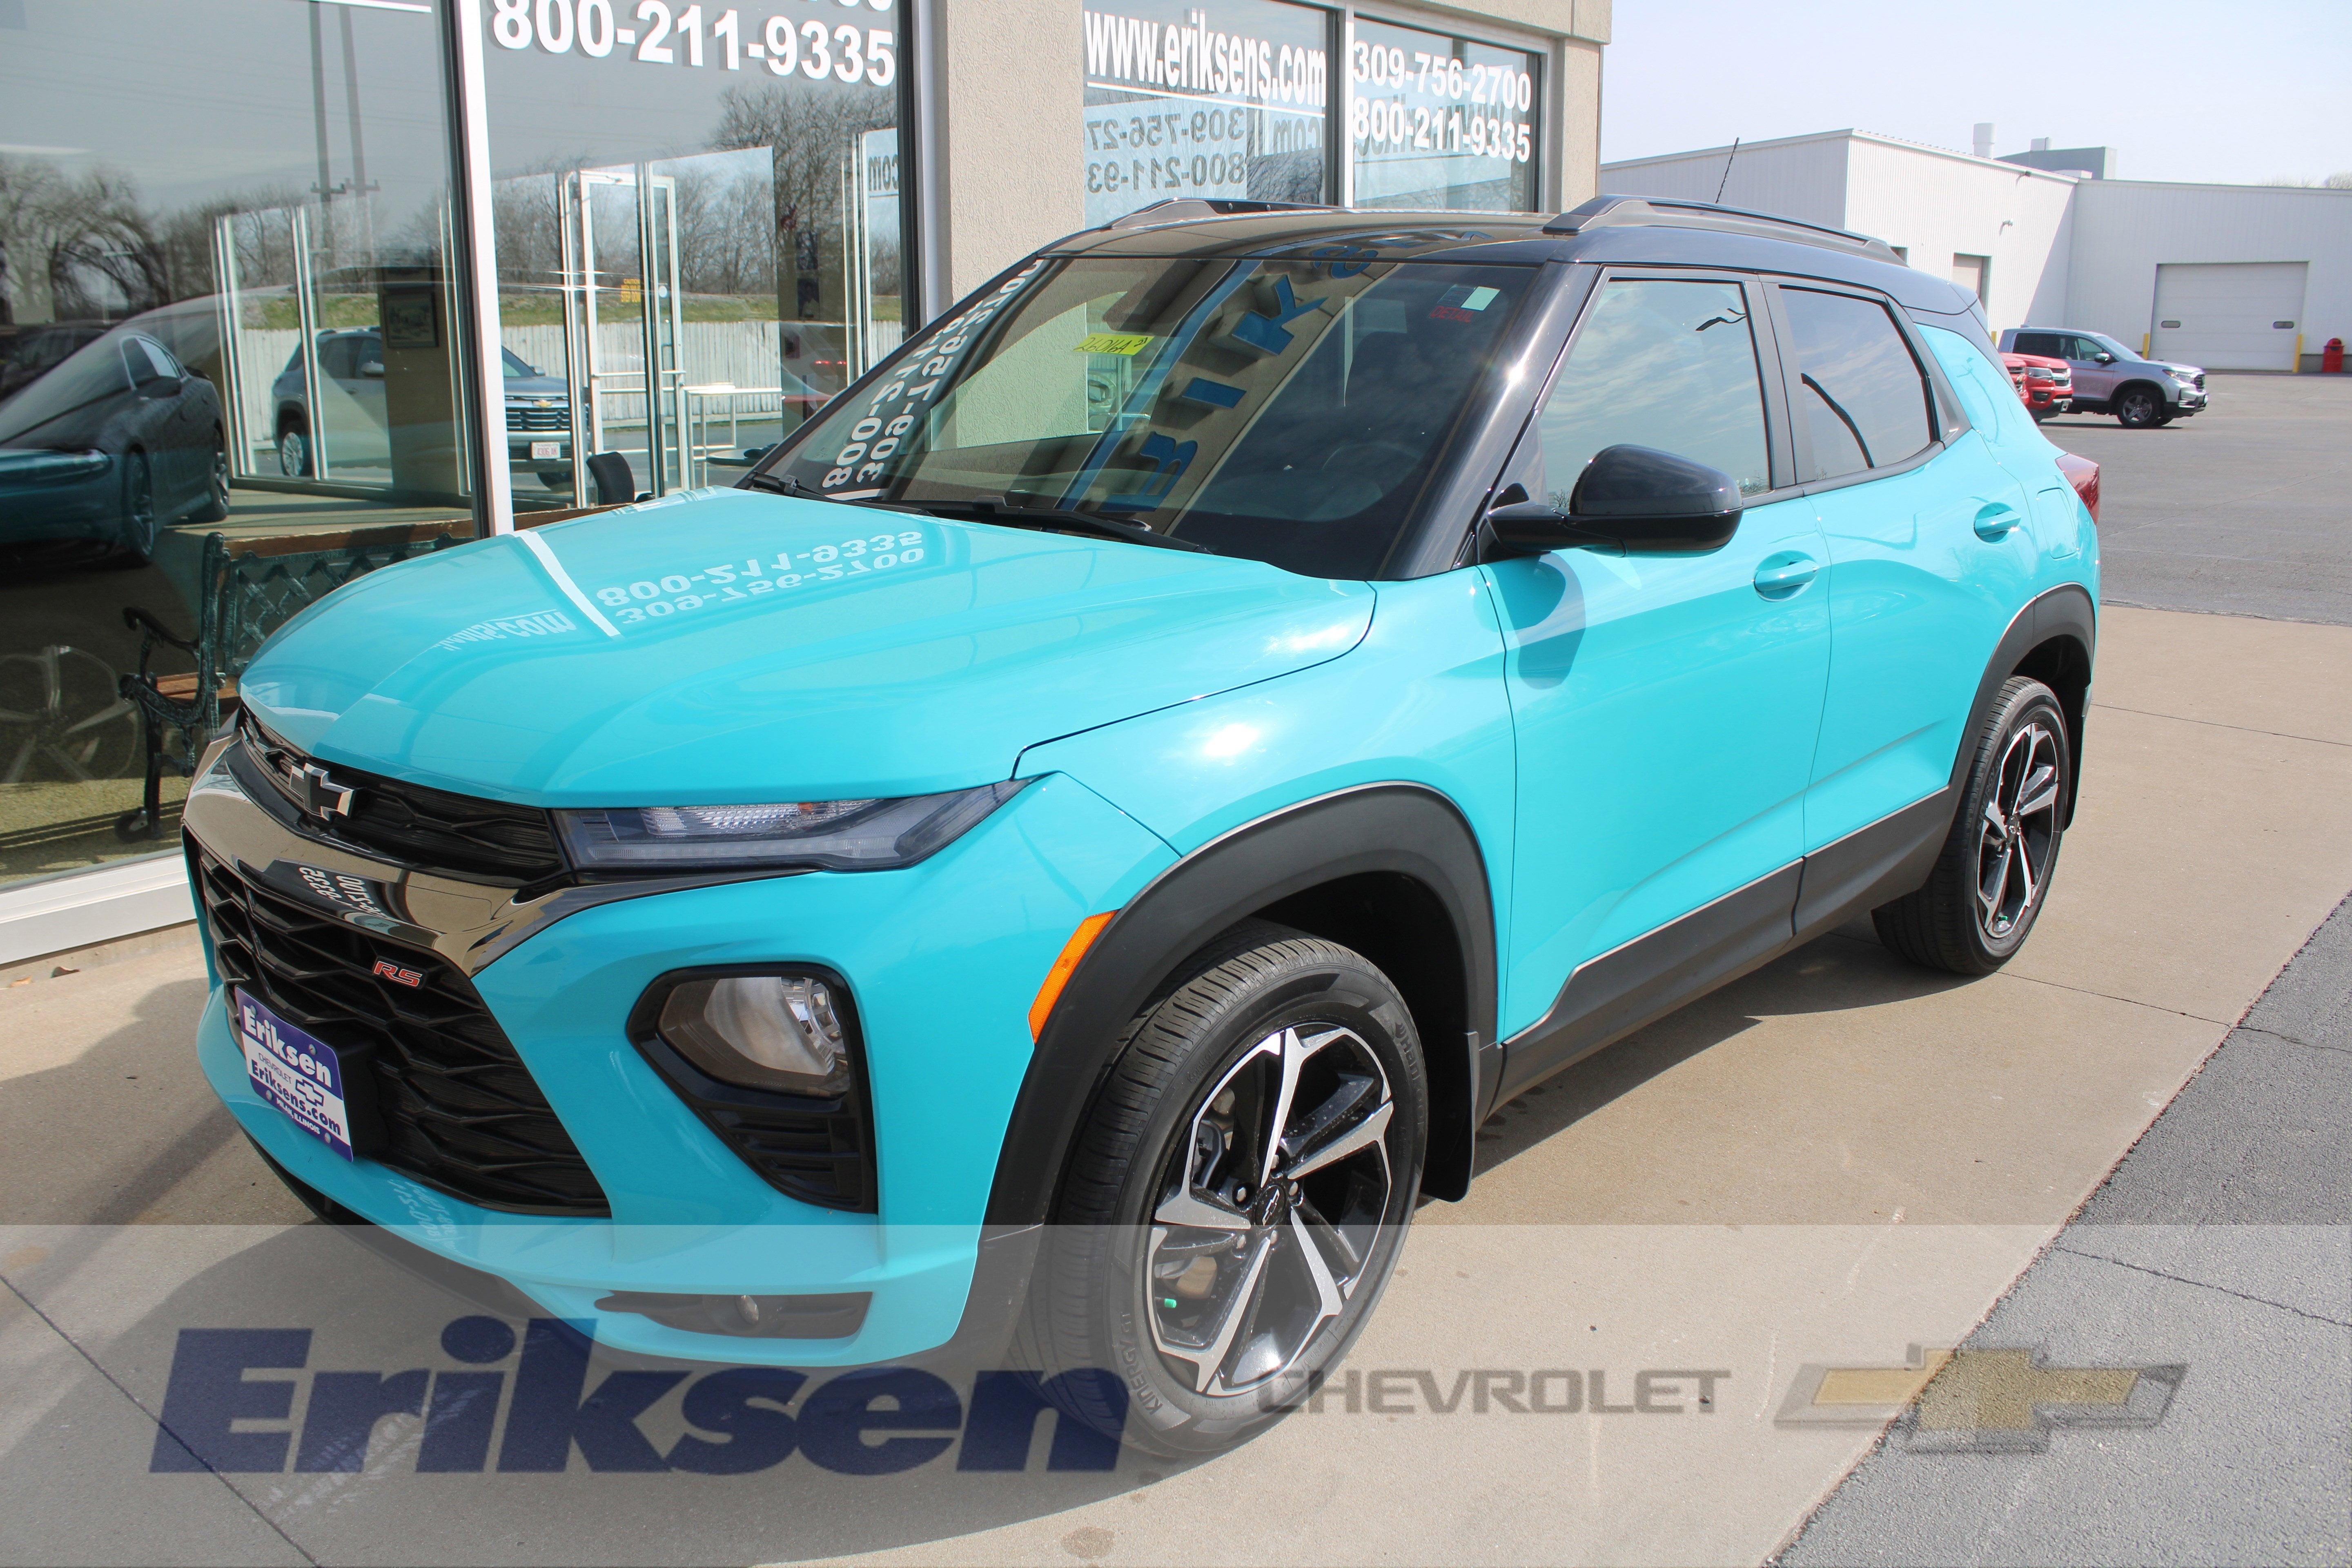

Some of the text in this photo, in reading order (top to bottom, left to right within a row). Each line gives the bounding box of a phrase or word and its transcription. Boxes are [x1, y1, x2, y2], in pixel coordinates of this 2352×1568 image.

[493, 0, 895, 87] 800-211-9335
[1084, 8, 1326, 108] www.eriksens.com
[1353, 40, 1531, 113] 309-756-2700
[1353, 96, 1530, 163] 800-211-9335
[373, 960, 423, 987] RS
[243, 1005, 332, 1088] Eriksen
[258, 1052, 293, 1085] CHEVROLET
[251, 1059, 341, 1136] Eriksens.com
[1120, 1339, 1163, 1415] KINERGY
